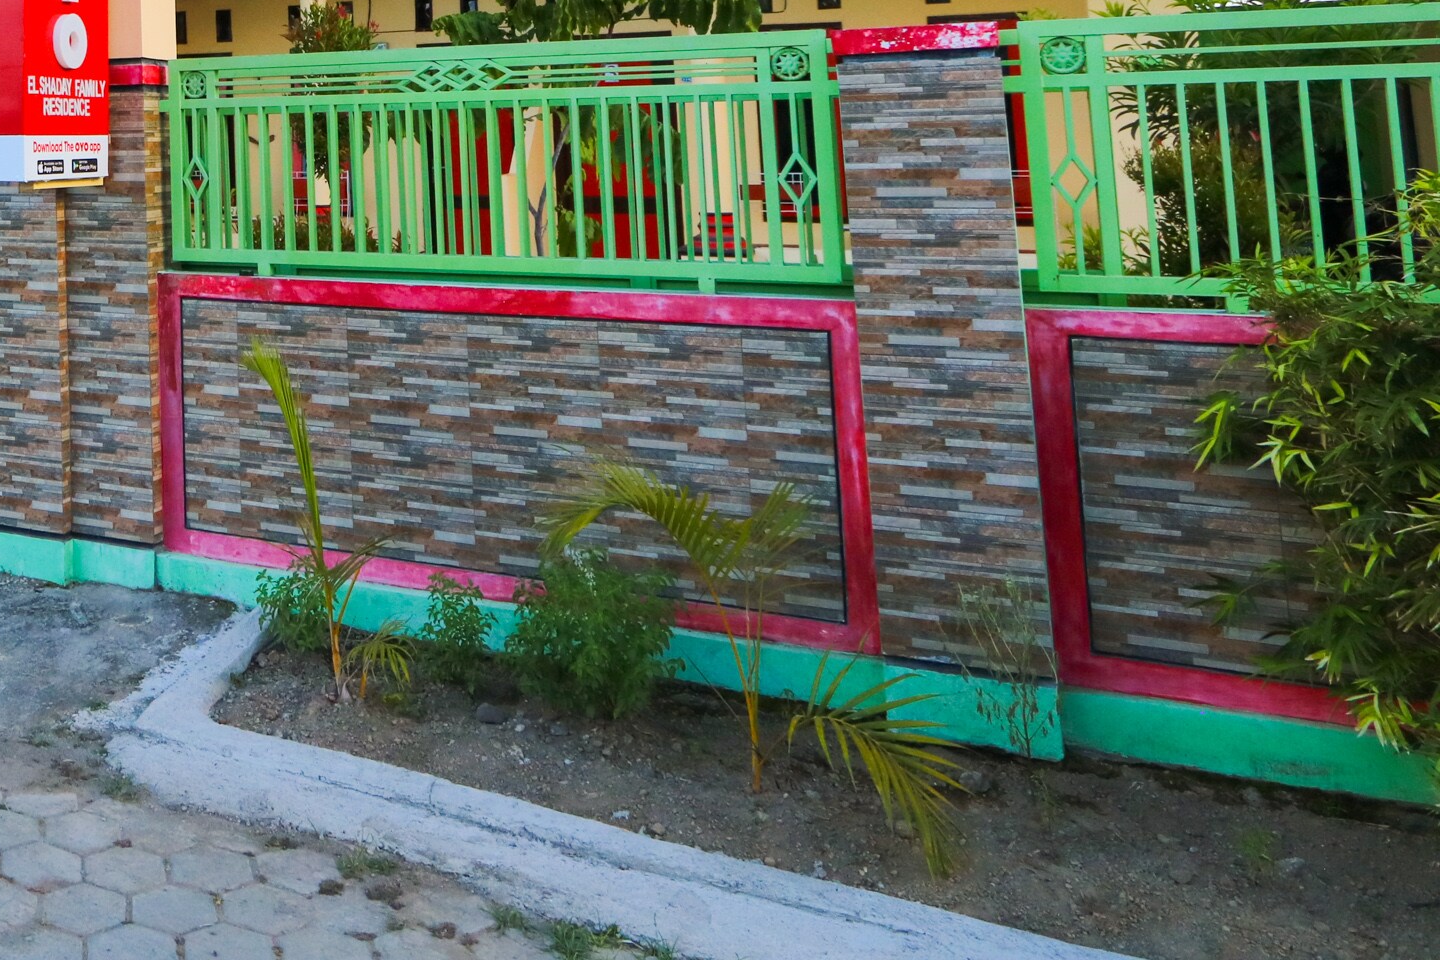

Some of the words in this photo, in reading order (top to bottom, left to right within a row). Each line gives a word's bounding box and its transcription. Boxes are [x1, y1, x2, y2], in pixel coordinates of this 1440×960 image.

[27, 75, 39, 95] EL
[39, 76, 72, 96] SHADAY
[74, 78, 106, 98] FAMILY
[43, 97, 91, 117] RESIDENCE
[33, 141, 63, 153] Download
[64, 141, 74, 152] The
[75, 142, 89, 152] OYO
[89, 143, 101, 154] app
[43, 166, 52, 174] App
